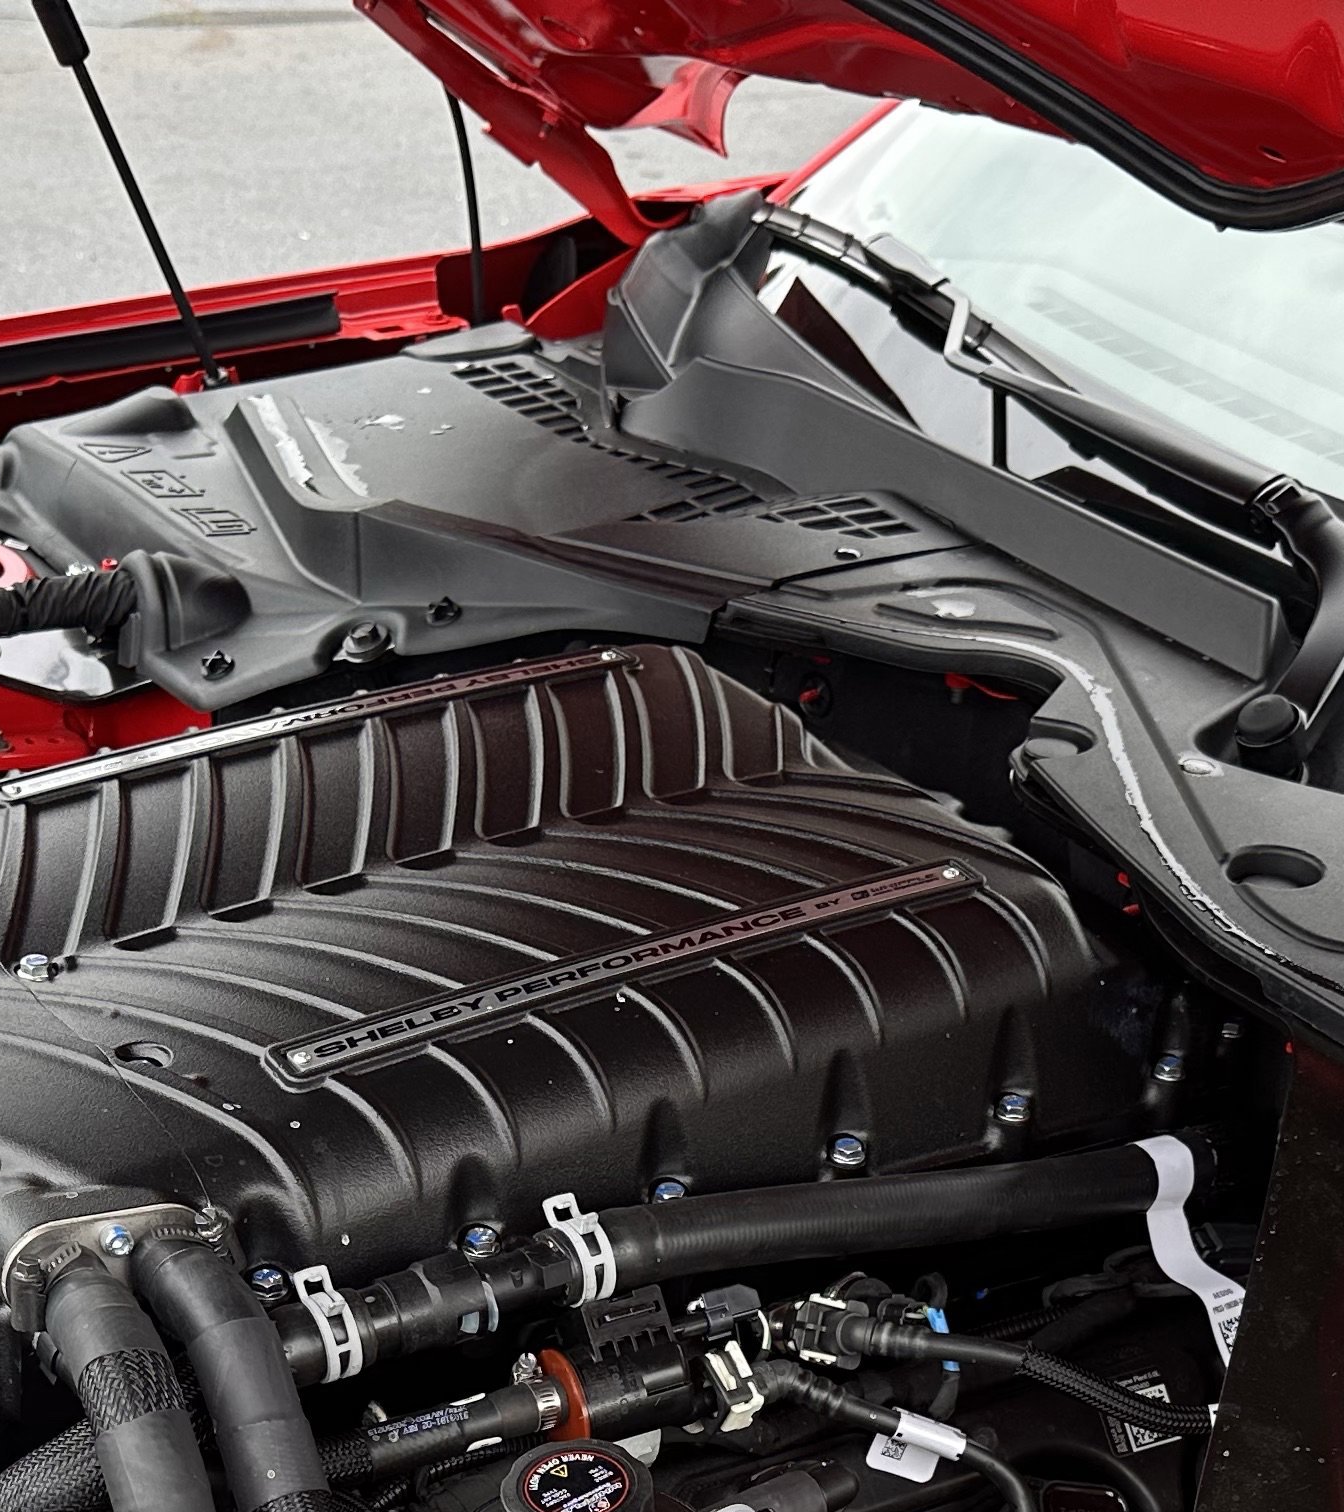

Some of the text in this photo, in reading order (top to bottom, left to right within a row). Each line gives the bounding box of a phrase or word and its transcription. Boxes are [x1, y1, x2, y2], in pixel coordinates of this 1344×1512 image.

[465, 652, 600, 689] SHELBY
[310, 992, 491, 1060] SHELBY
[493, 903, 807, 1007] PERFORMANCE
[813, 897, 841, 912] BY
[536, 1458, 561, 1474] OPEN
[560, 1453, 595, 1464] NEVER
